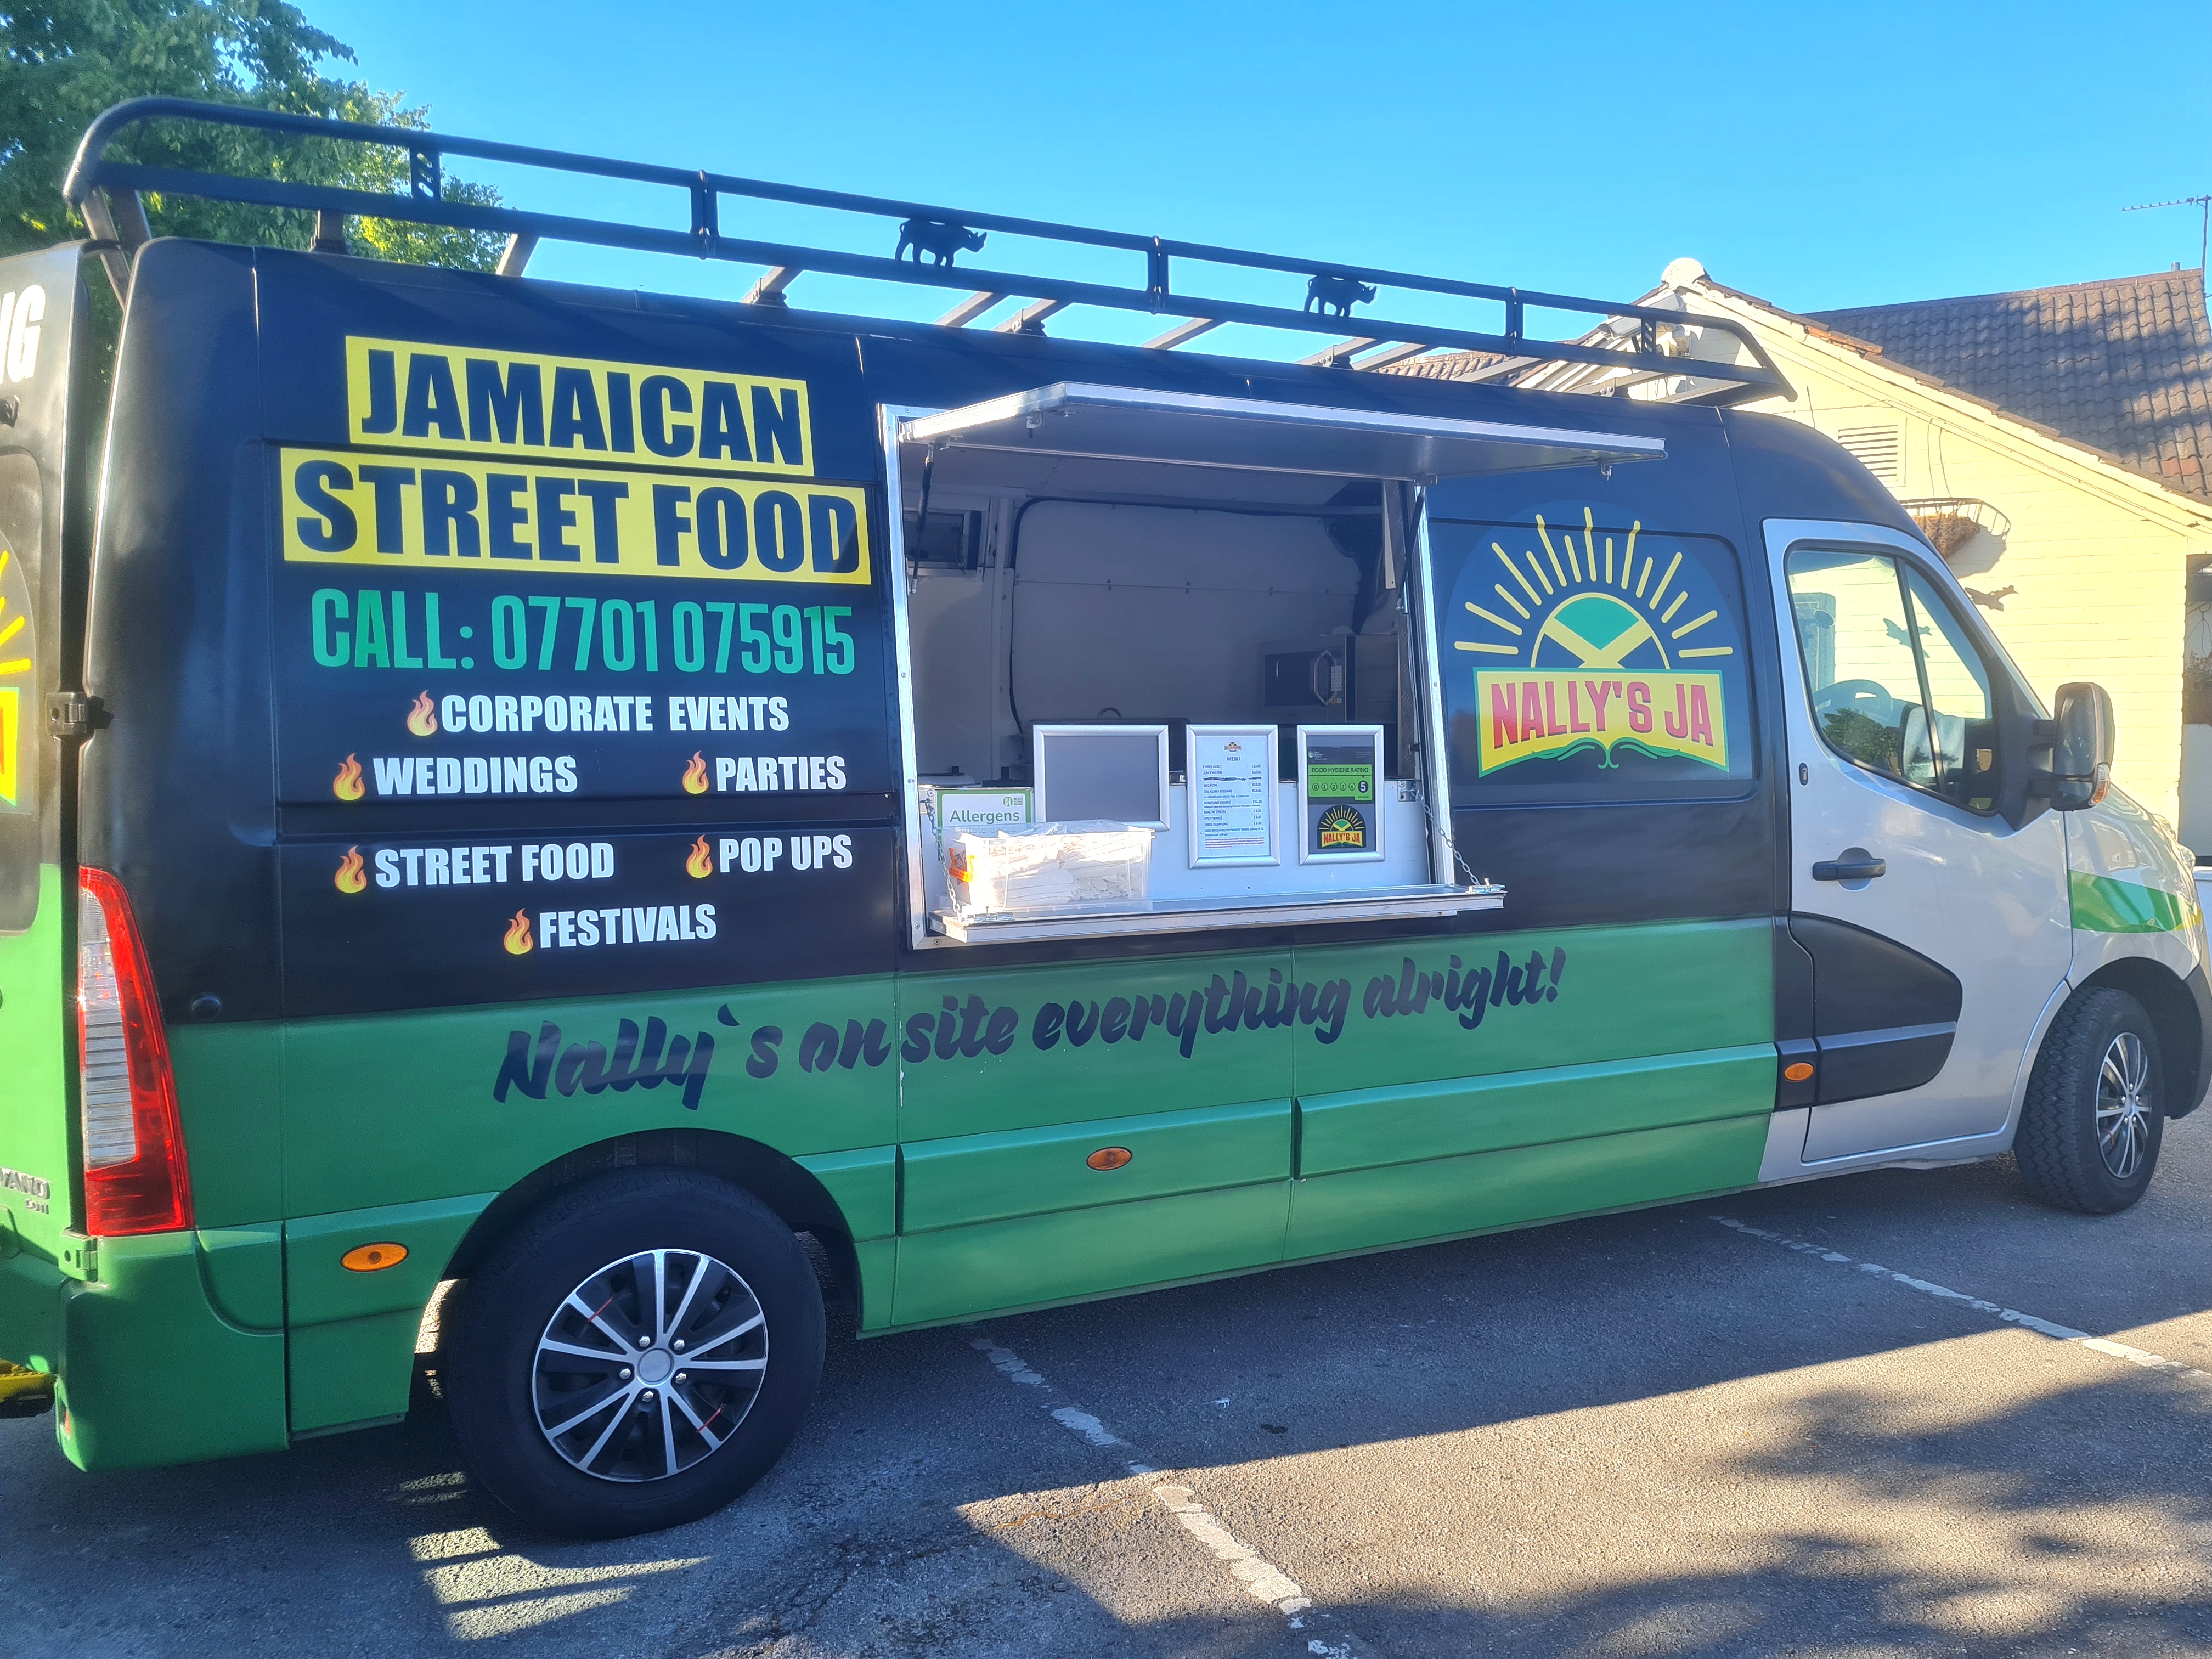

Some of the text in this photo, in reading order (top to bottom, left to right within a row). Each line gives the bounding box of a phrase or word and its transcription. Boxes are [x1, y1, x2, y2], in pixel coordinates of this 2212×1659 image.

[362, 348, 804, 465] JAMAICAN
[294, 459, 860, 574] STREET FOOD
[312, 588, 855, 675] CALL: 07701 075915
[442, 695, 789, 732] CORPORATE EVENTS
[1491, 680, 1713, 749] NALLY'S JA
[373, 755, 578, 795] WEDDINGS
[716, 755, 846, 792] PARTIES
[1360, 782, 1366, 792] 5
[950, 809, 1020, 825] Allergens
[719, 834, 853, 873] POP UPS
[1323, 833, 1361, 844] NALLY'S JA
[375, 843, 615, 888] STREET FOOD
[540, 904, 716, 949] FESTIVALS
[798, 1018, 892, 1074] on
[901, 994, 1019, 1063] site
[1032, 968, 1351, 1059] everything
[1363, 946, 1566, 1030] alright!
